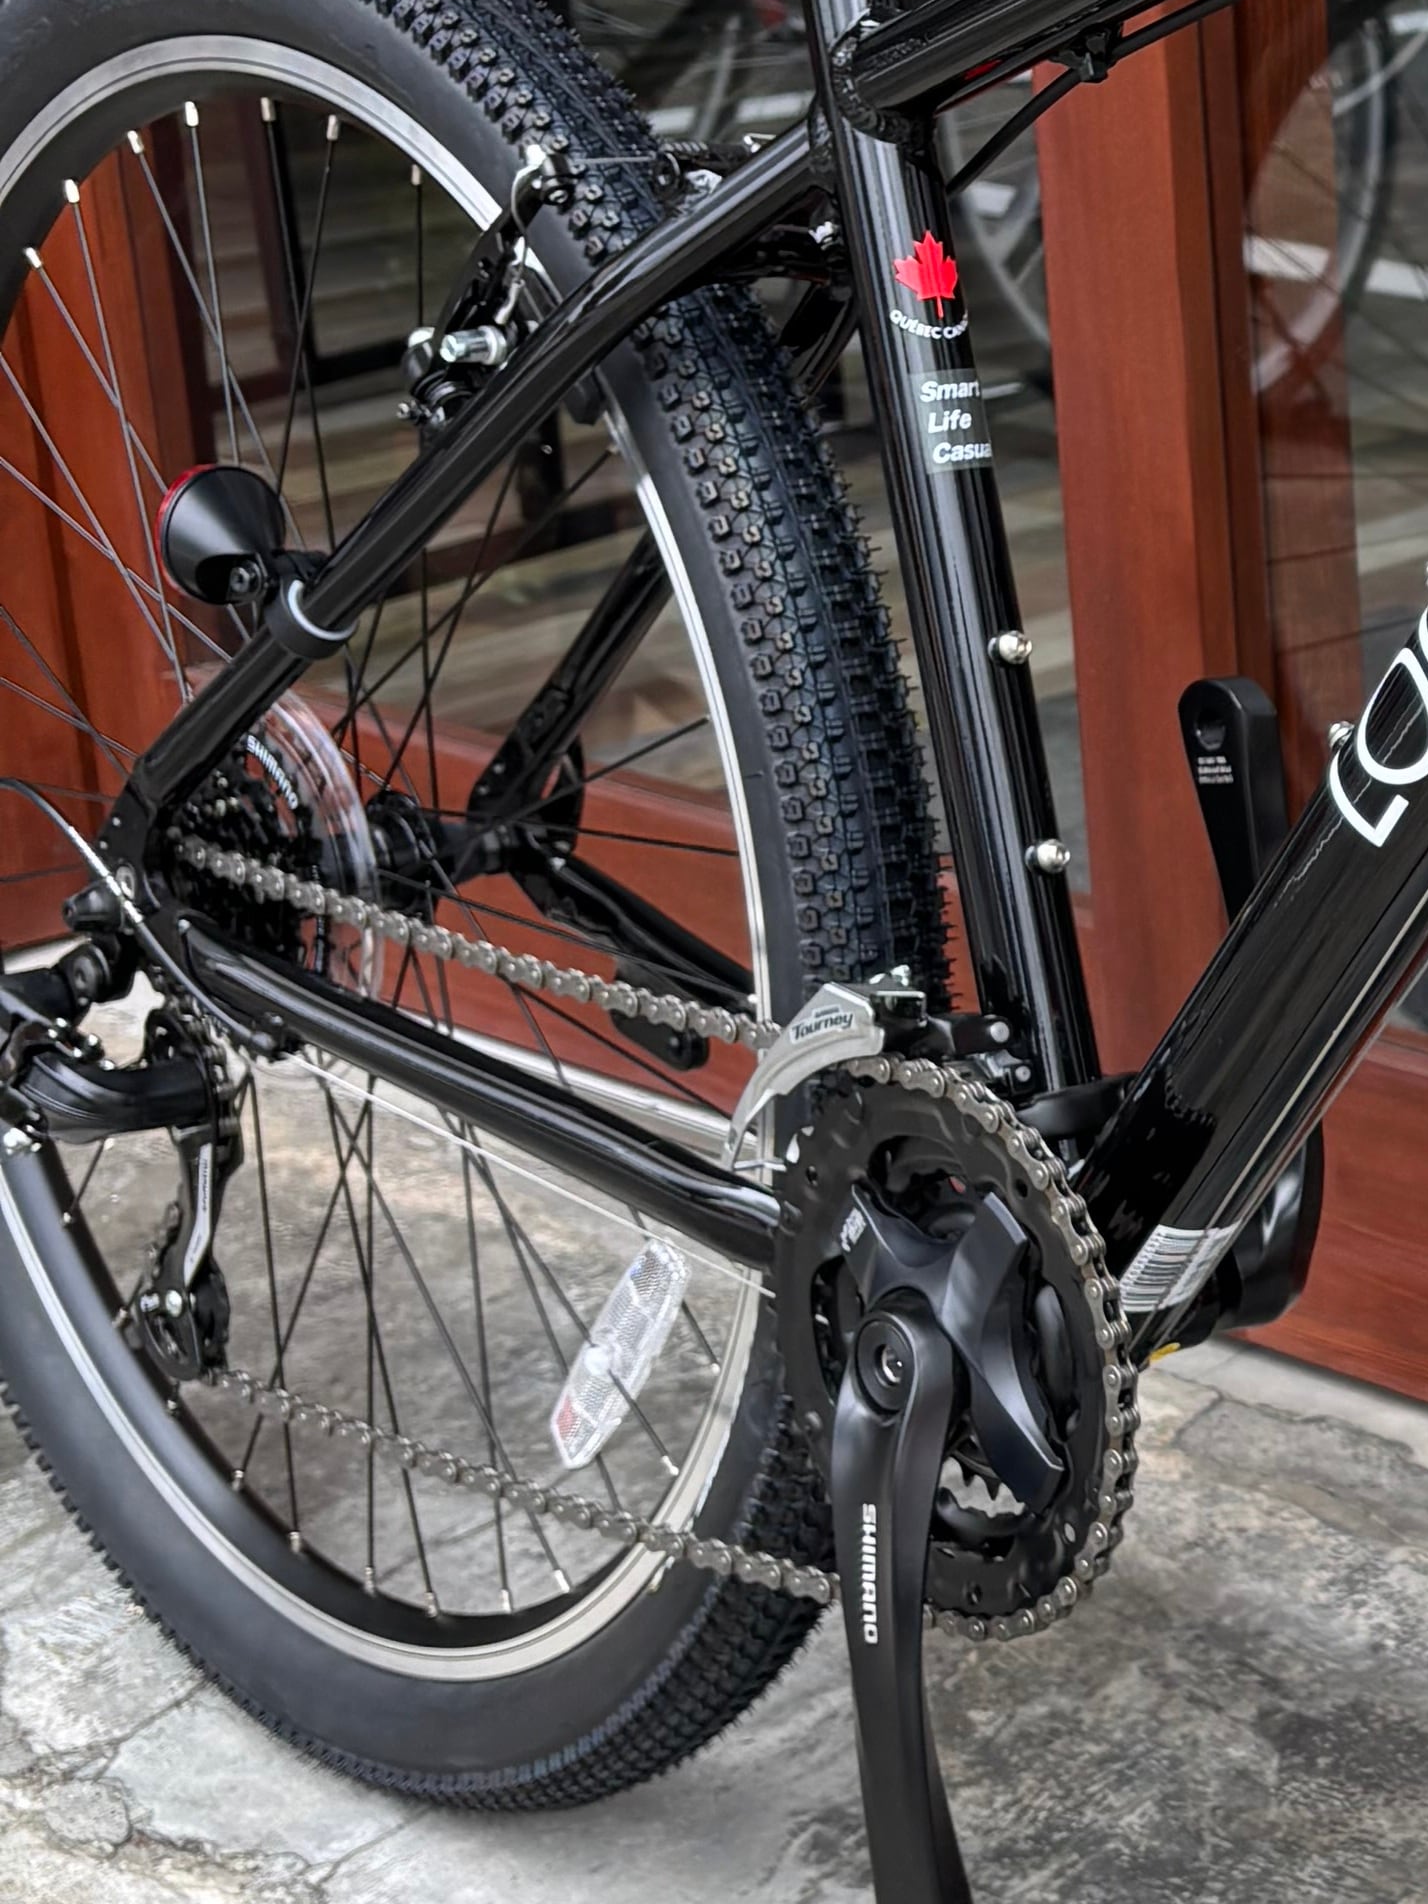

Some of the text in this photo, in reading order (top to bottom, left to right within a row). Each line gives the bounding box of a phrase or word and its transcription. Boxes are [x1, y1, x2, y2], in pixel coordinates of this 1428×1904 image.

[928, 408, 972, 434] Life
[932, 440, 993, 464] Casua
[791, 1013, 854, 1041] Tourney
[861, 1502, 878, 1645] SHIMANO
